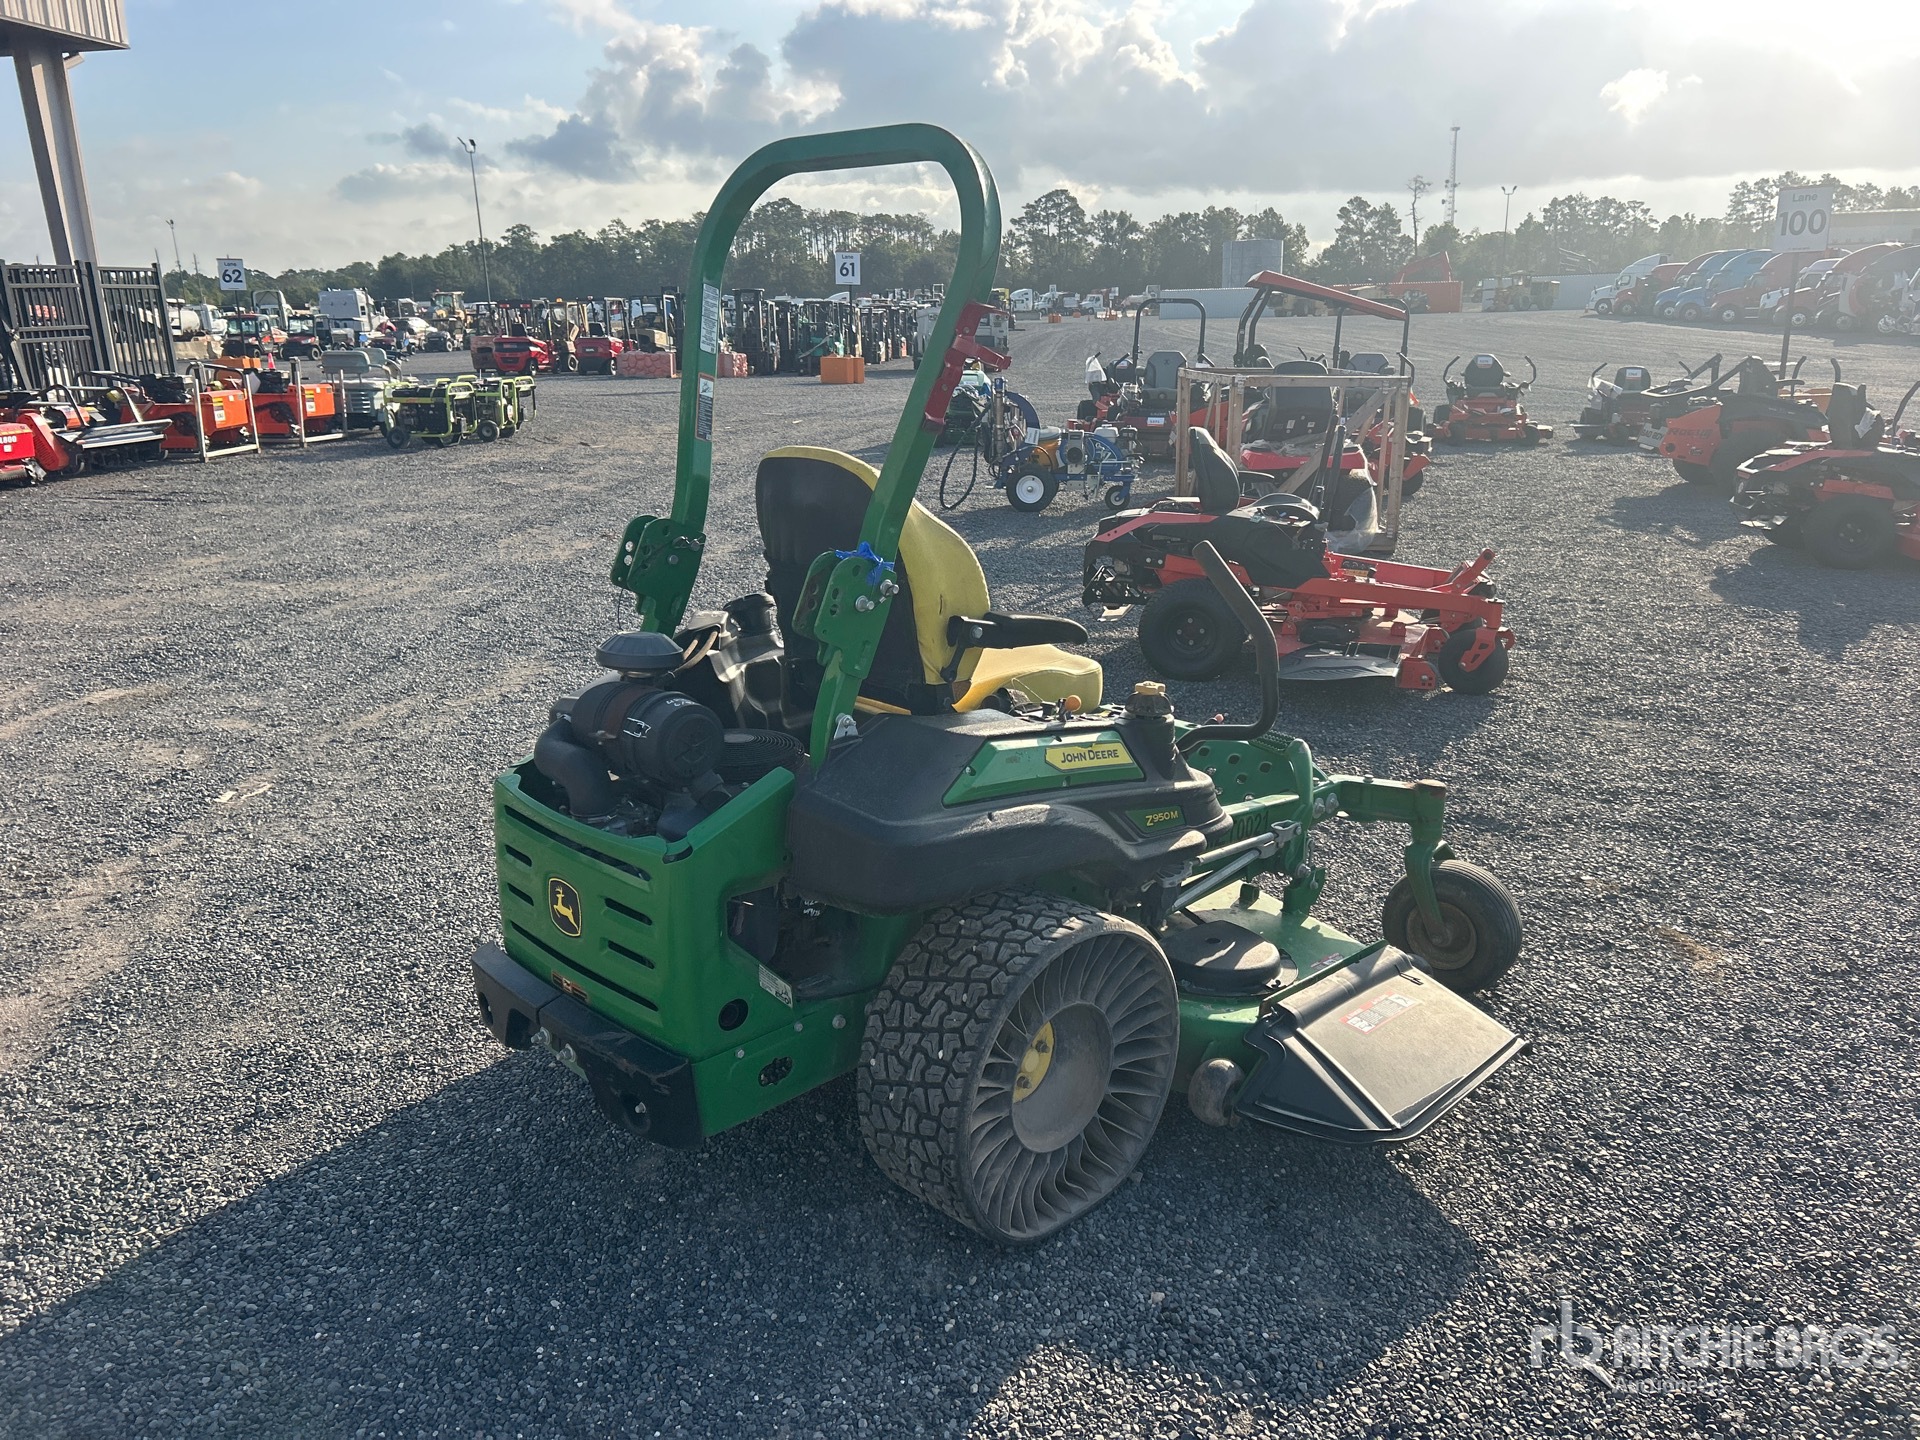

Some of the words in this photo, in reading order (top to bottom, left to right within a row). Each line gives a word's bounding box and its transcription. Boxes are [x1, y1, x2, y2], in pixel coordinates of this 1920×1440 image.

[1792, 193, 1818, 202] Lane
[1779, 208, 1827, 236] 100
[222, 268, 243, 283] 62
[839, 261, 855, 277] 61
[1061, 751, 1087, 764] JOHN
[1087, 749, 1120, 761] DEERE
[1145, 810, 1179, 827] Z950M
